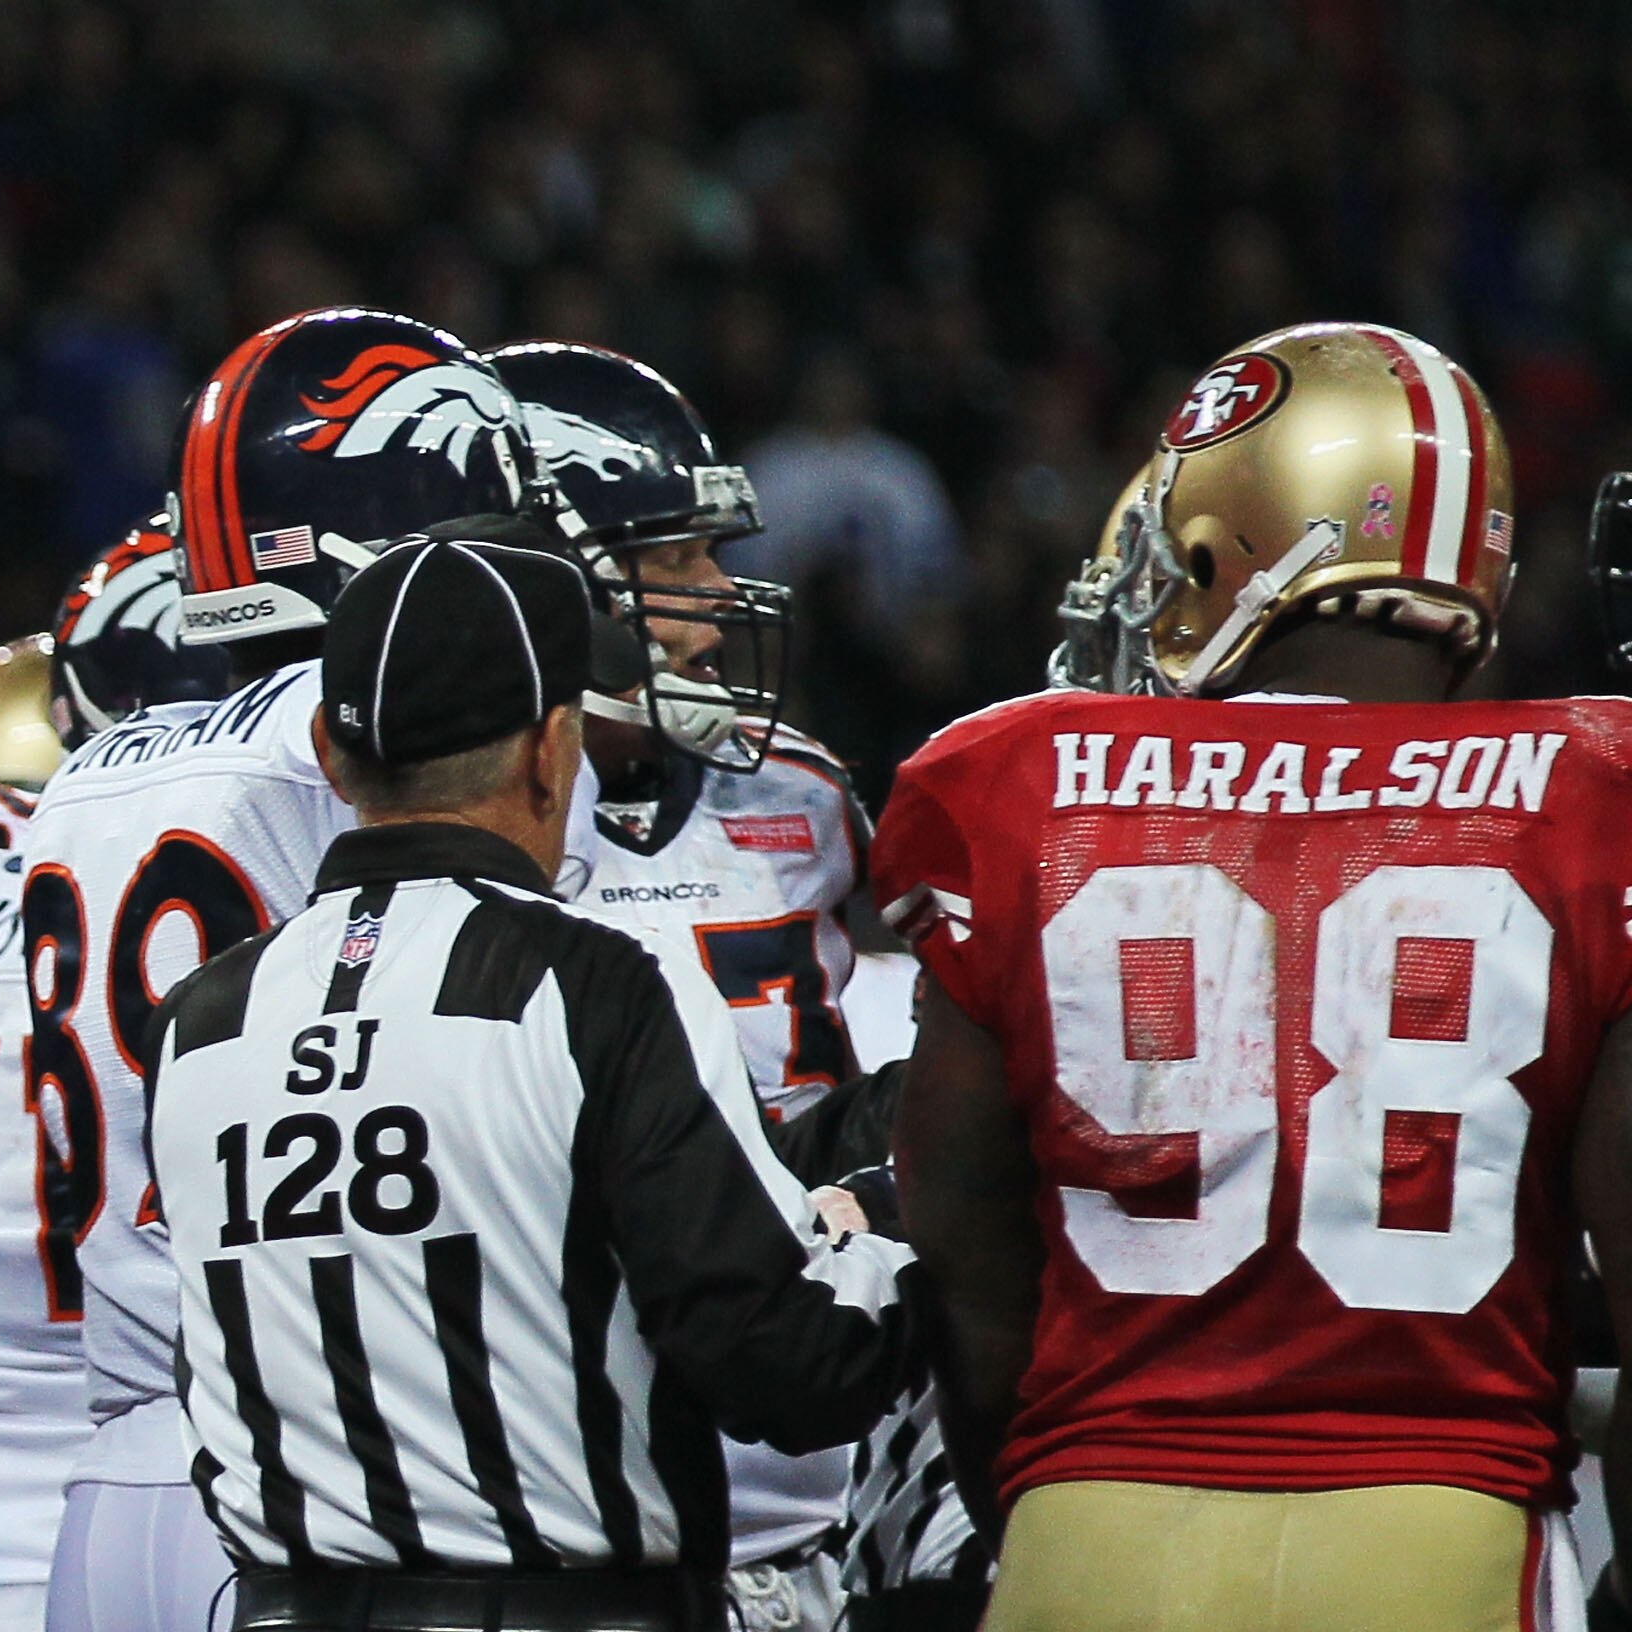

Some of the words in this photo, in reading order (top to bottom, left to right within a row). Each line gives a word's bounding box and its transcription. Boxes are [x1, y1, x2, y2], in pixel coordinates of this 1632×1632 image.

[186, 599, 277, 628] BRONCOS
[1052, 731, 1568, 814] HARALSON
[600, 882, 721, 904] BRONCOS
[286, 1018, 380, 1096] SJ
[1041, 863, 1555, 1316] 98
[216, 1105, 440, 1248] 128
